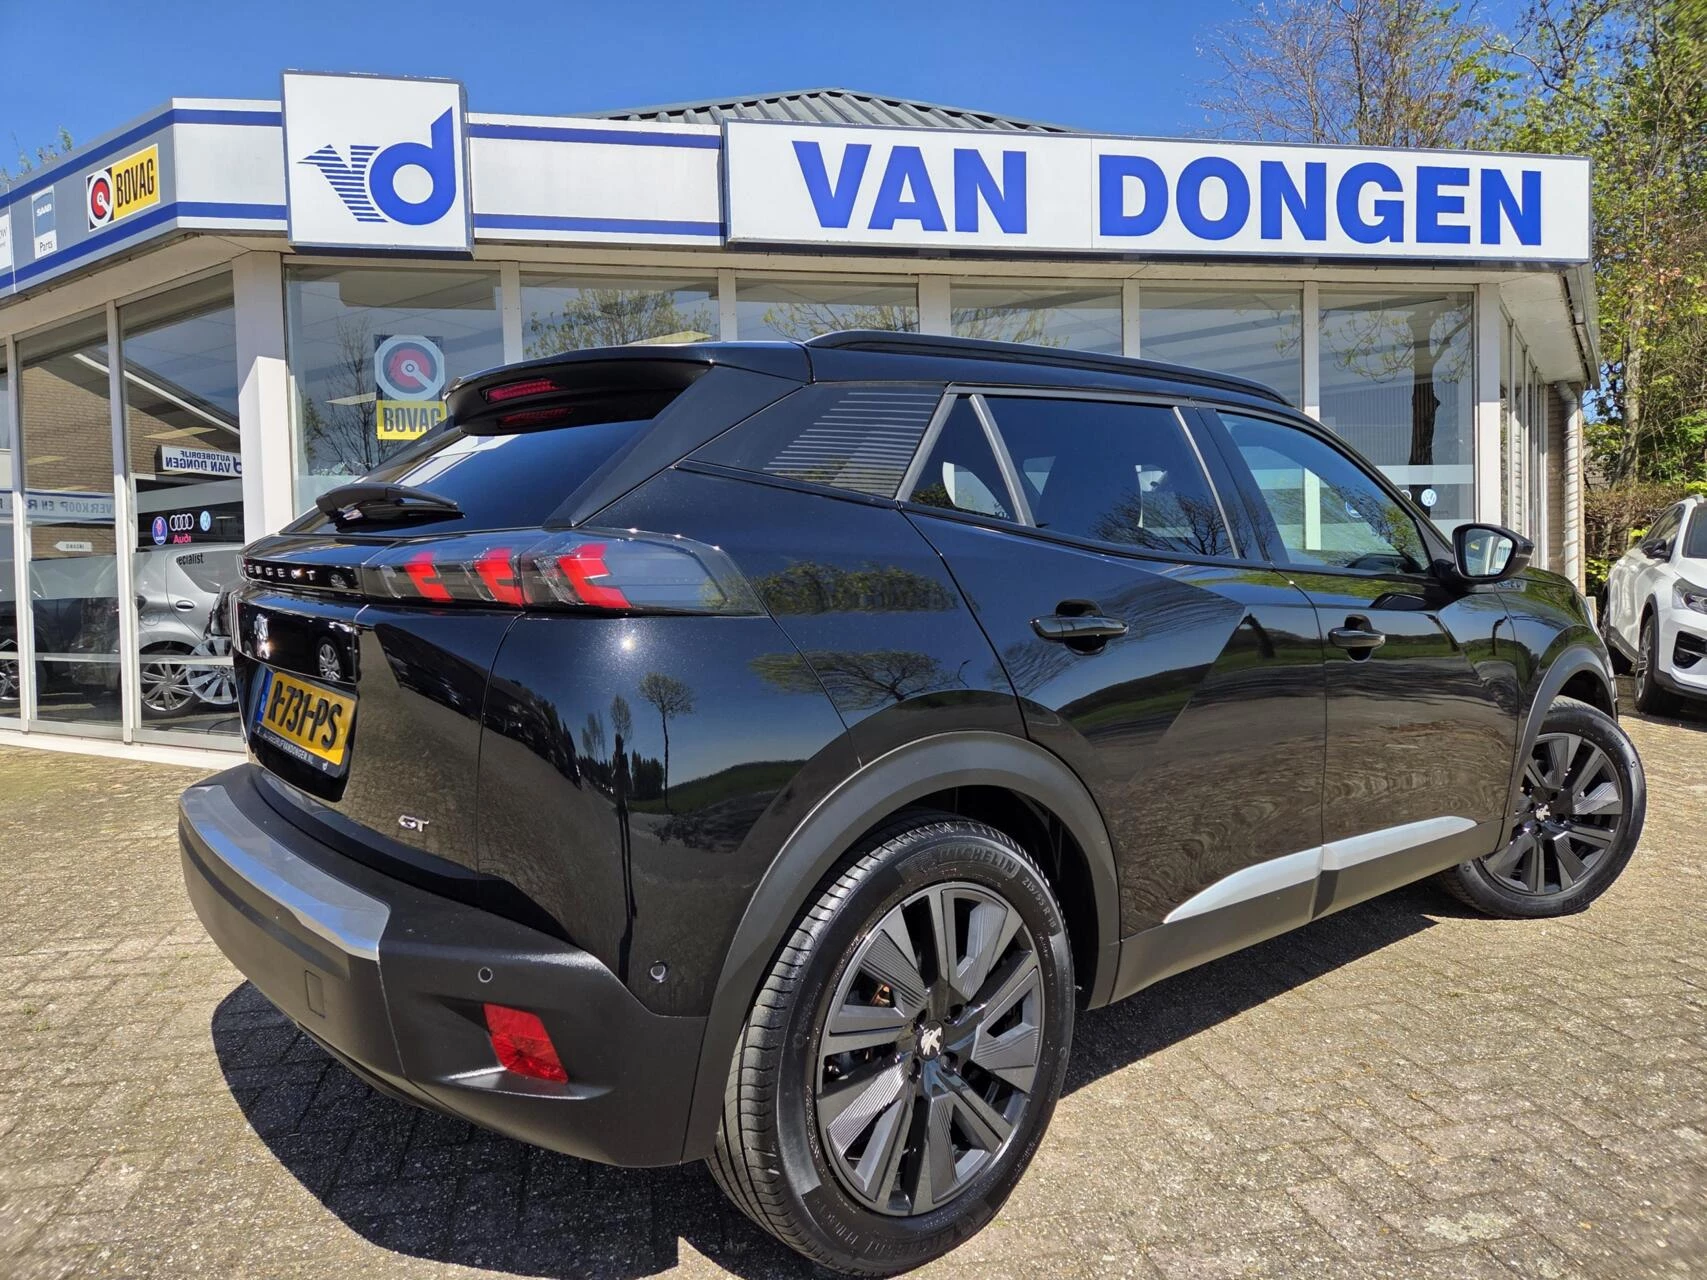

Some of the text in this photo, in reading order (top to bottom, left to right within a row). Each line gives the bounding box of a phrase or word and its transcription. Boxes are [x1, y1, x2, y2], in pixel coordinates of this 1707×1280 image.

[116, 158, 155, 208] BOVAG
[791, 140, 1542, 246] VAN DONGEN
[383, 408, 441, 432] BOVAG
[173, 533, 192, 545] Audi
[176, 553, 204, 566] ecialist
[268, 680, 343, 752] R-731-PS
[398, 814, 430, 832] GT
